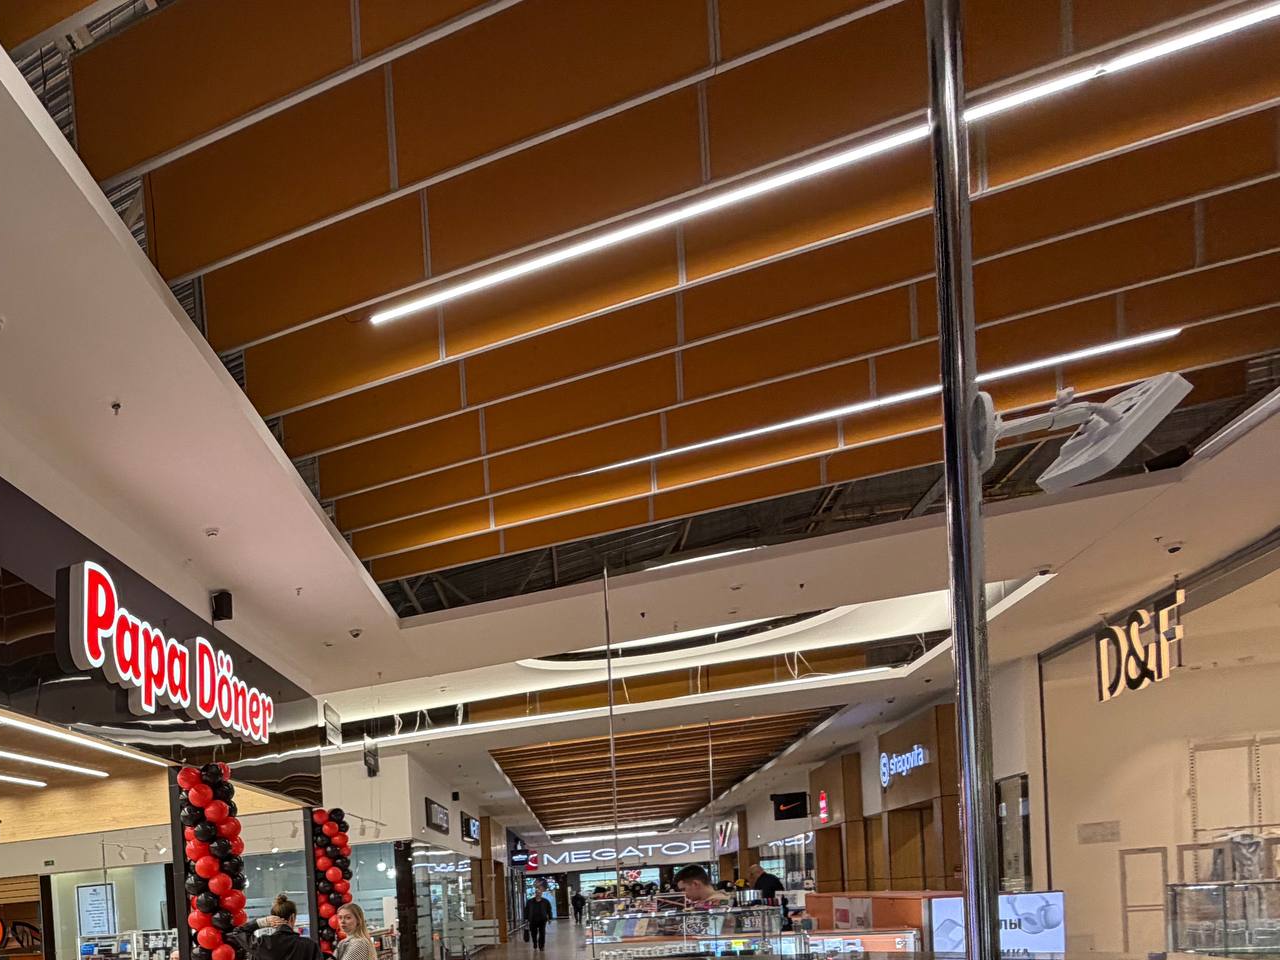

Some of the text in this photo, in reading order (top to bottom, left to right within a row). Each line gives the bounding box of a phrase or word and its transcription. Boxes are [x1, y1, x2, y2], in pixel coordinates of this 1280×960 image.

[85, 564, 272, 741] Papa Döner
[1095, 589, 1185, 702] D&F
